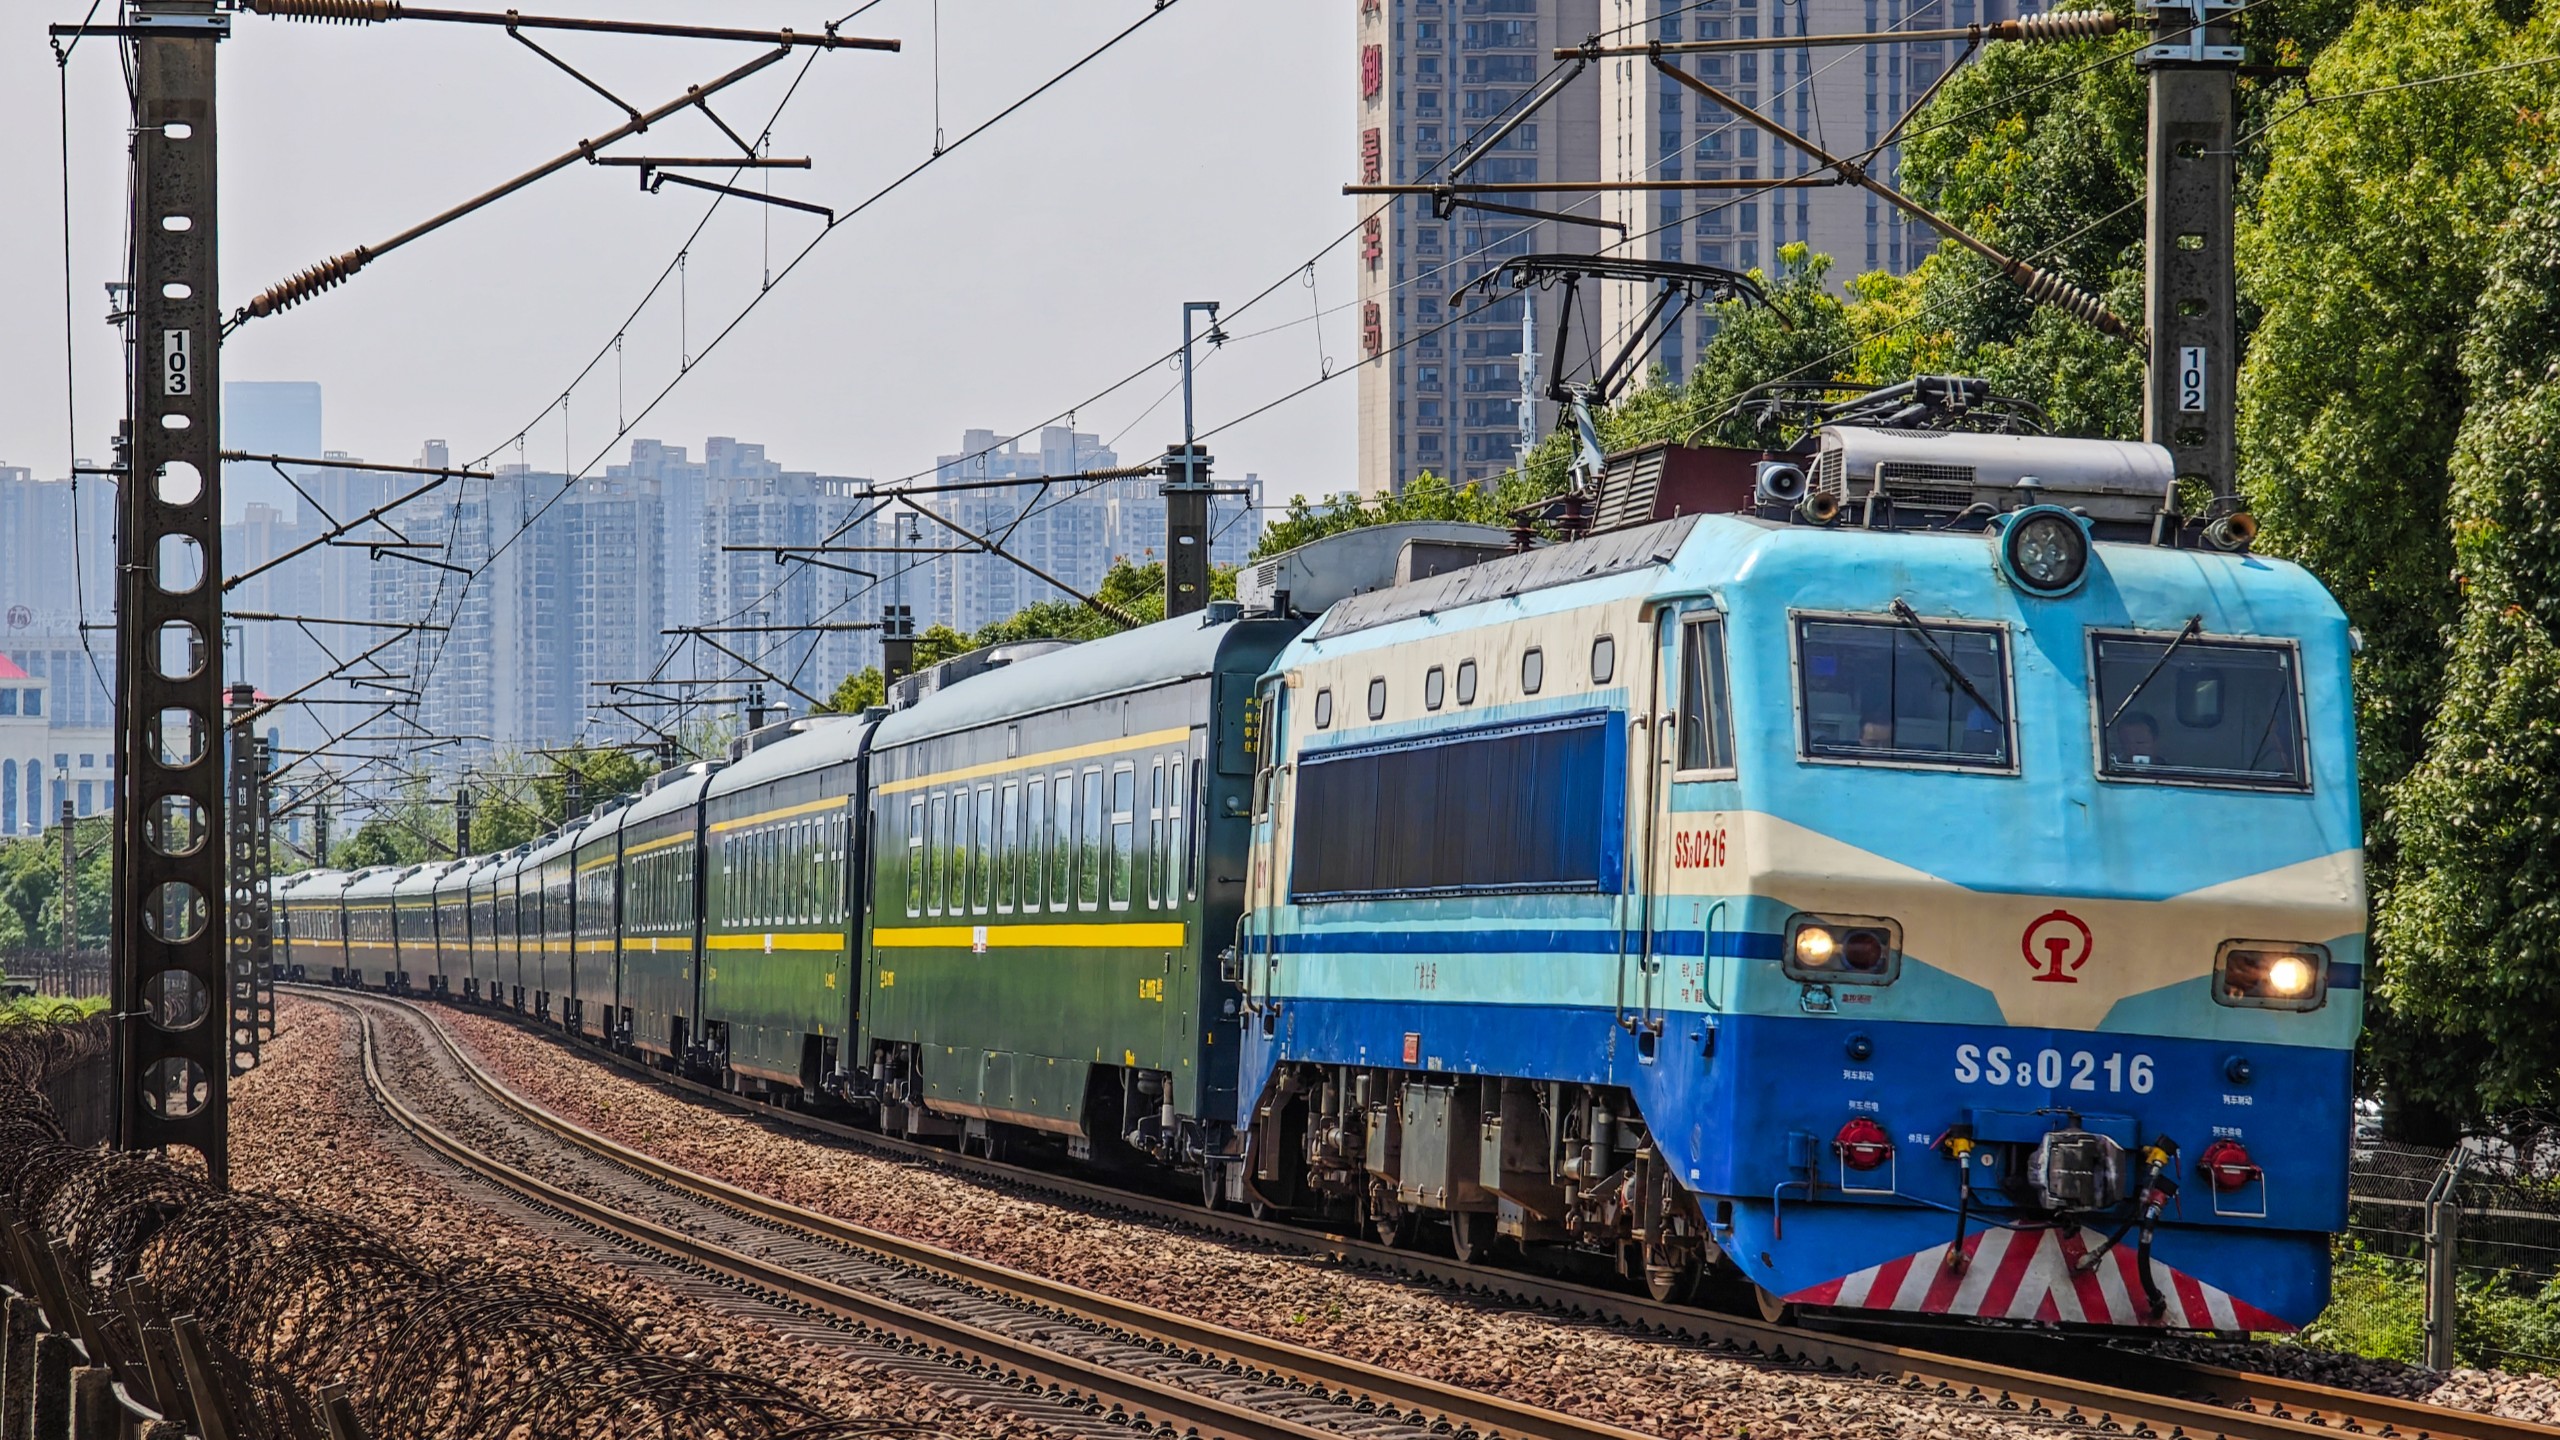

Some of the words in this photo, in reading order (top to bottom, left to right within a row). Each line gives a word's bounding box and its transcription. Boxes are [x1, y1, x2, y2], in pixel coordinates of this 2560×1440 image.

[169, 331, 186, 393] 103
[2184, 349, 2200, 409] 102
[1208, 1032, 1213, 1044] 1
[1843, 1069, 1874, 1081] 列车制动
[1954, 1044, 2154, 1094] SS80216
[1848, 1100, 1879, 1112] 列车供电
